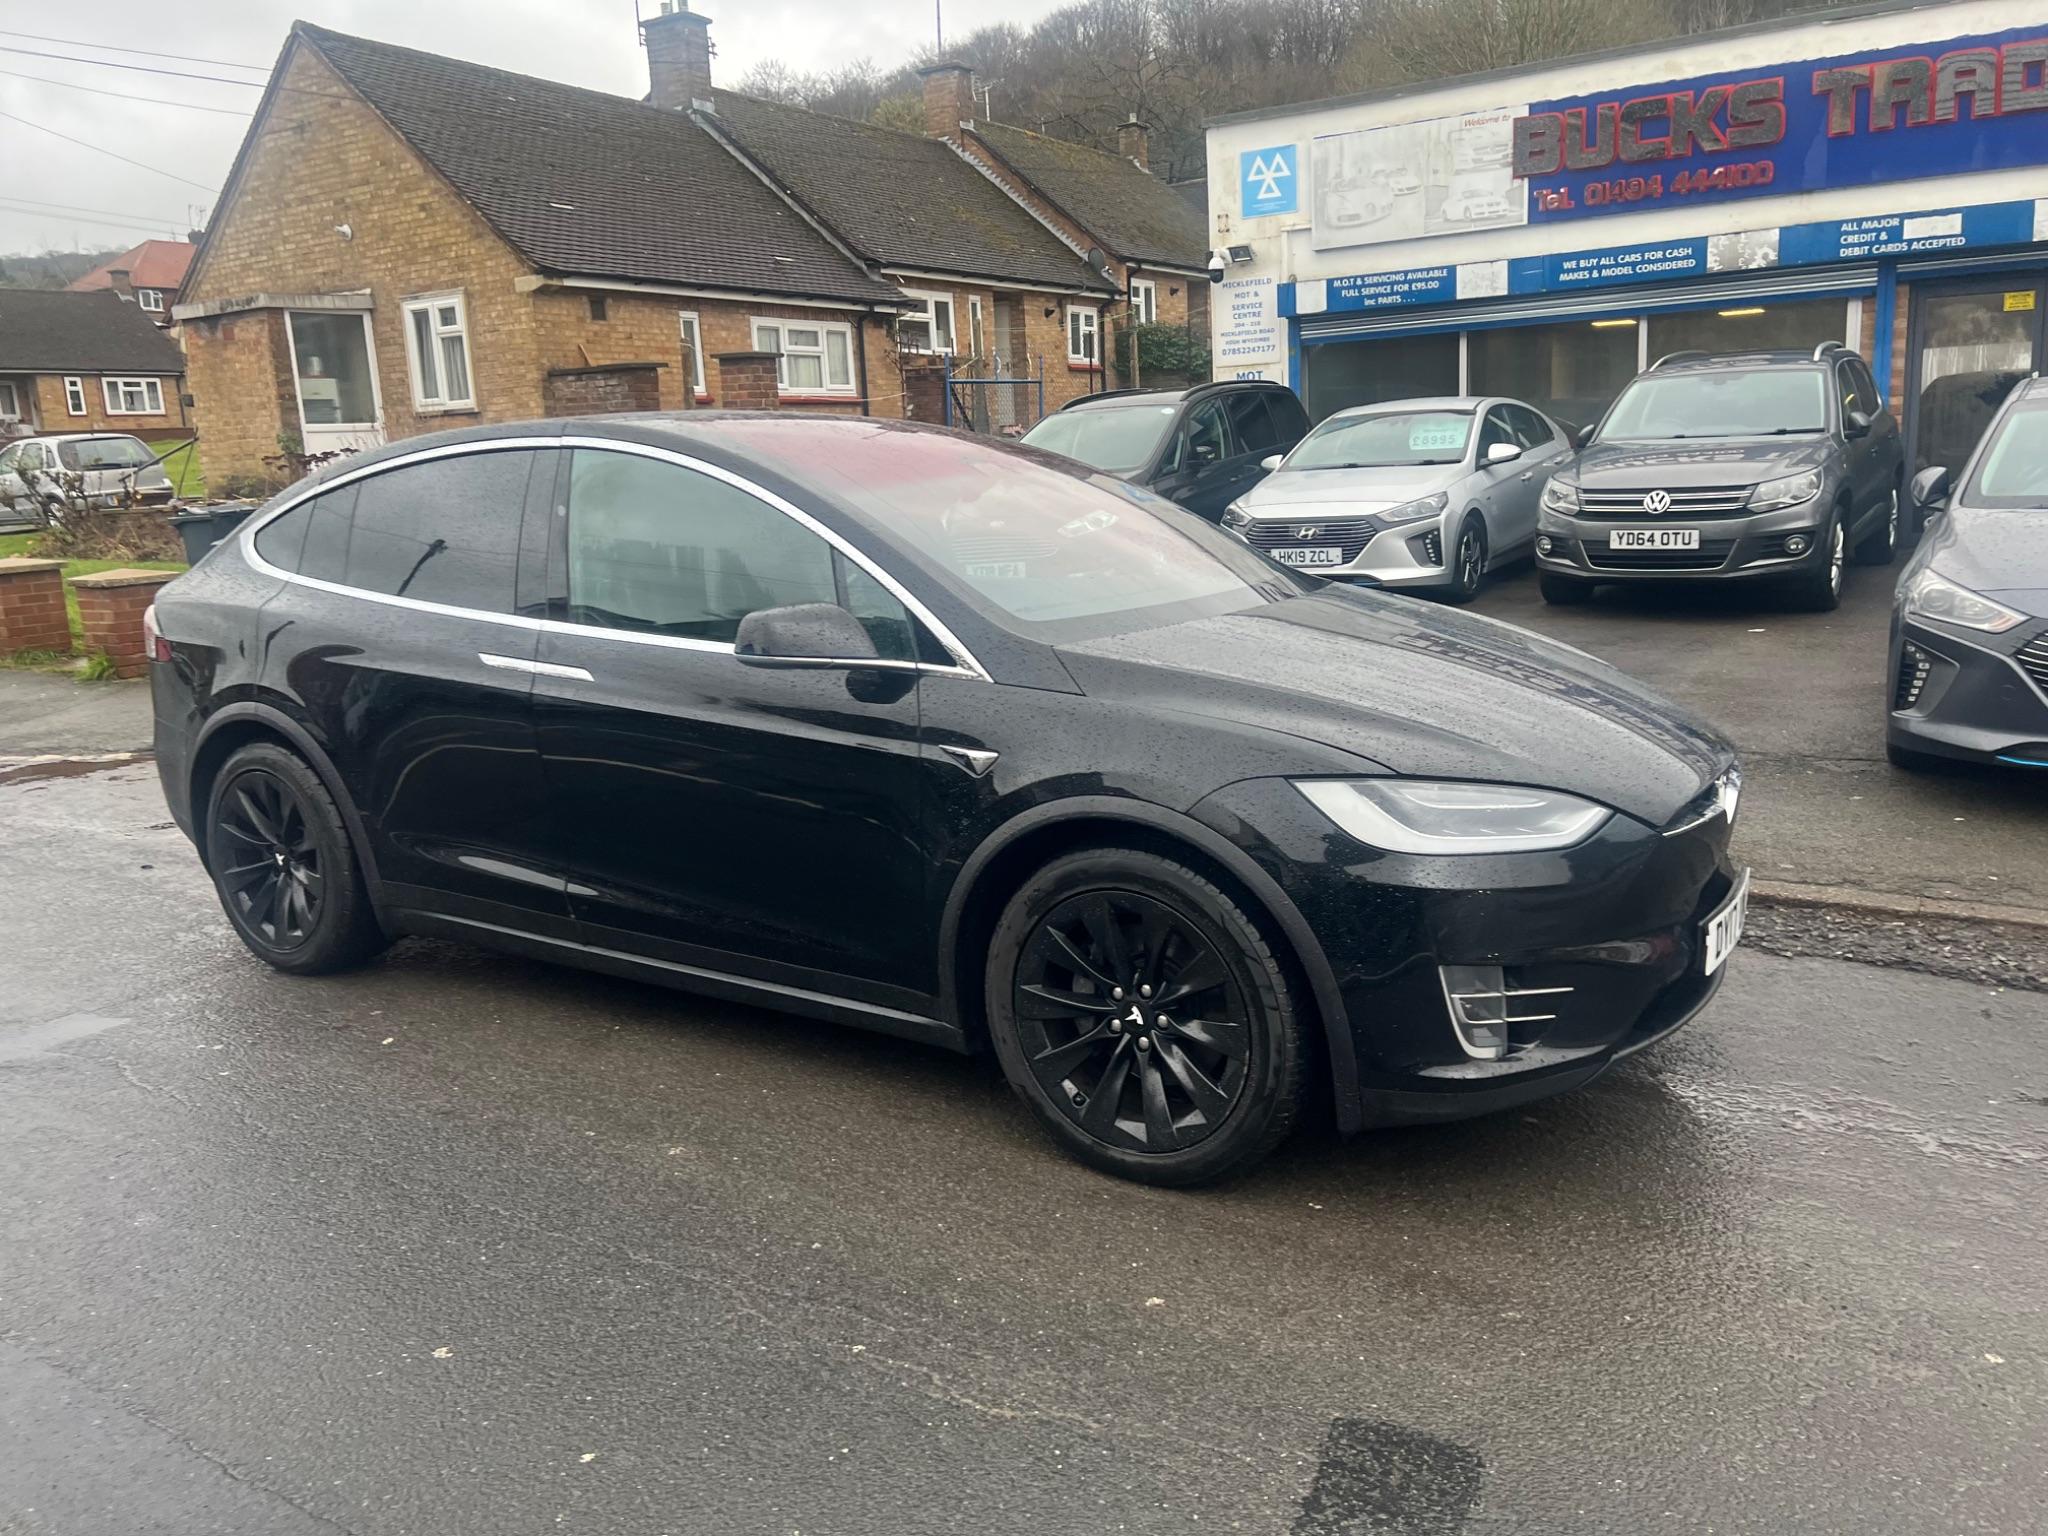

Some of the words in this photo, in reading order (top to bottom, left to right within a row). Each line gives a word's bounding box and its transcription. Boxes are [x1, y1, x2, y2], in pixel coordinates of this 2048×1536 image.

[1512, 76, 1786, 179] BUCKS
[1583, 174, 1664, 206] 01494
[1670, 160, 1775, 196] 444100
[1841, 221, 1859, 232] ALL
[1861, 217, 1900, 230] MAJOR
[1840, 232, 1876, 245] CREDIT
[1879, 231, 1888, 241] &
[1839, 245, 1869, 257] DEBIT
[1872, 241, 1908, 254] CARDS
[1910, 236, 1966, 251] ACCEPTED
[1562, 260, 1577, 269] WE
[1579, 258, 1598, 268] BUY
[1600, 256, 1615, 265] ALL
[1618, 253, 1642, 263] CARS
[1644, 250, 1663, 260] FOR
[1665, 247, 1692, 258] CASH
[1559, 271, 1590, 281] MAKES
[1592, 269, 1599, 278] &
[1601, 266, 1633, 277] MODEL
[1635, 258, 1696, 273] CONSIDERED
[1222, 278, 1272, 289] MICKLEFIELD
[1356, 278, 1362, 286] &
[1364, 272, 1405, 284] SERVICING
[1407, 268, 1448, 280] AVAILABLE
[1234, 291, 1250, 299] MOT
[1341, 288, 1359, 297] FULL
[1361, 285, 1392, 296] SERVICE
[1393, 283, 1410, 292] FOR
[1411, 280, 1440, 291] £95.00
[1231, 302, 1263, 311] SERVICE
[1378, 295, 1402, 305] PARTS
[1232, 310, 1262, 320] CENTRE
[1236, 370, 1263, 381] MOT
[1616, 532, 1656, 546] YD64
[1660, 532, 1692, 546] OTU
[1278, 550, 1305, 563] HK19
[1309, 550, 1333, 563] ZCL
